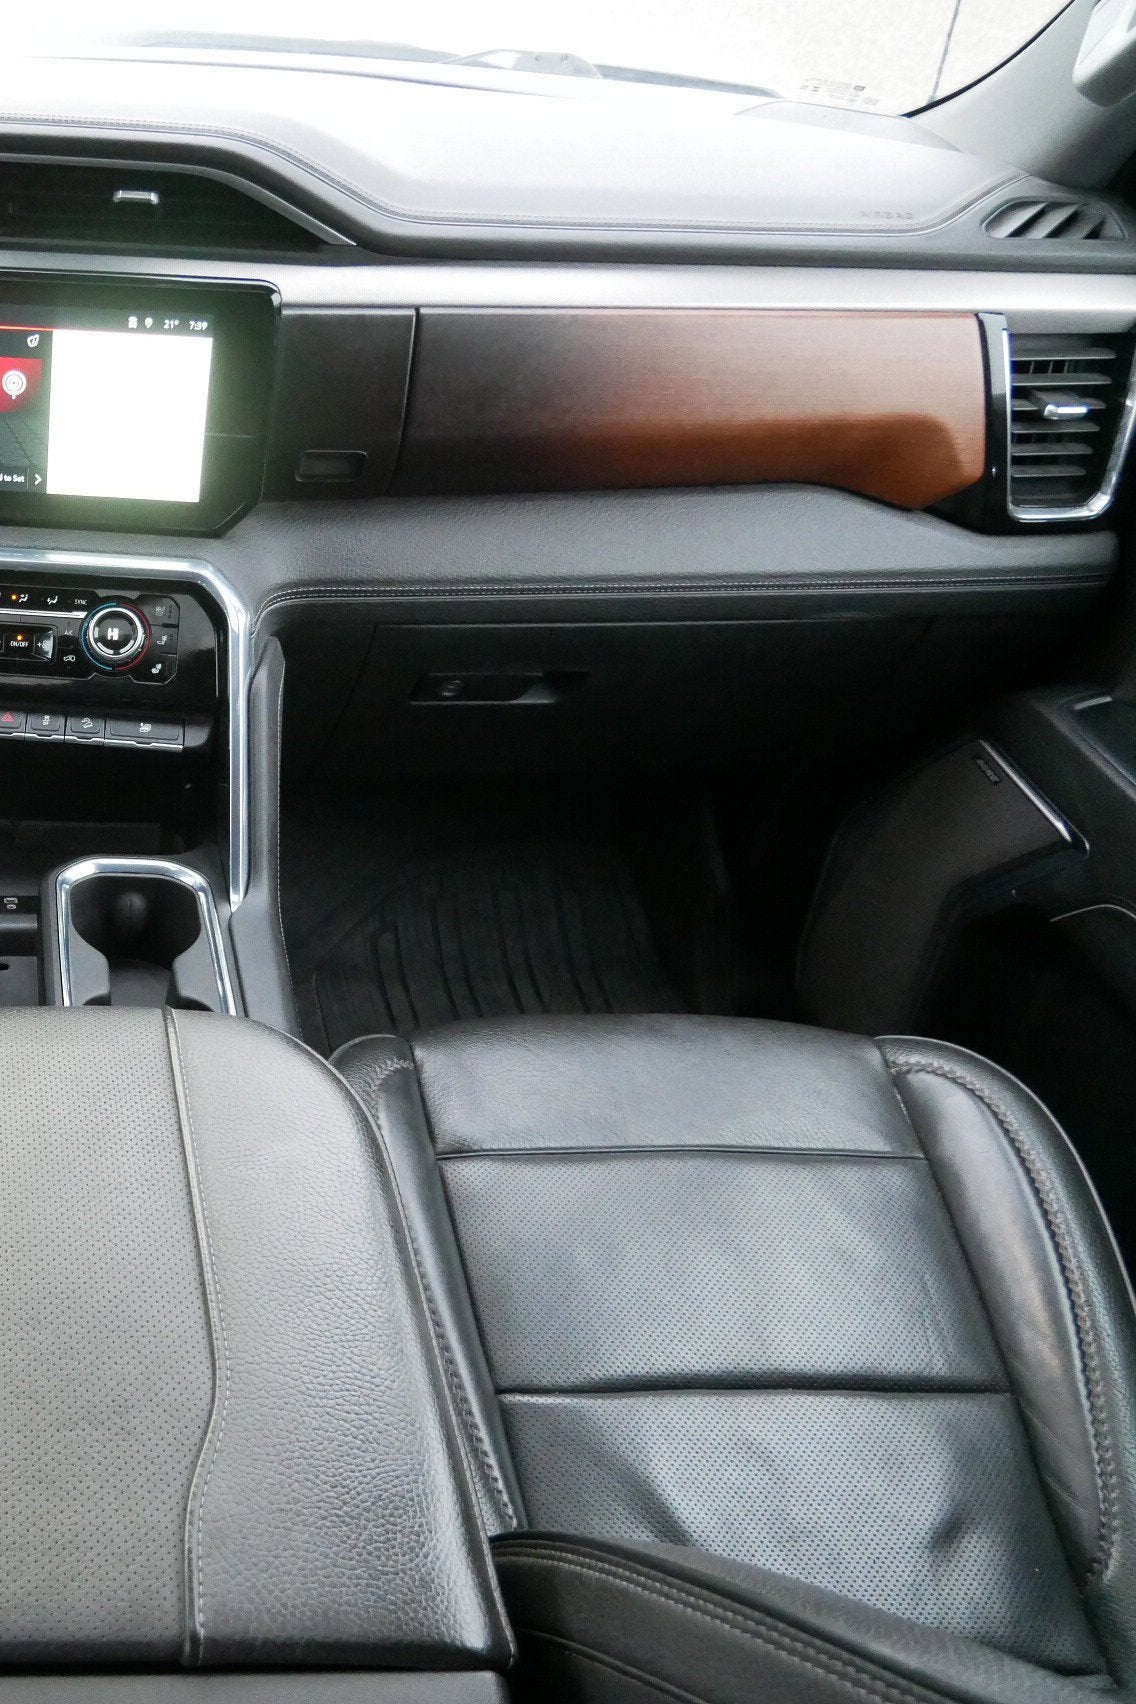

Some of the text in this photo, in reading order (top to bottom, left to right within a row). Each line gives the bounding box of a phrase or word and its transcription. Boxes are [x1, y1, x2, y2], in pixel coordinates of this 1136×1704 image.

[189, 320, 209, 331] 7:39
[4, 474, 12, 482] to
[12, 474, 25, 483] Set
